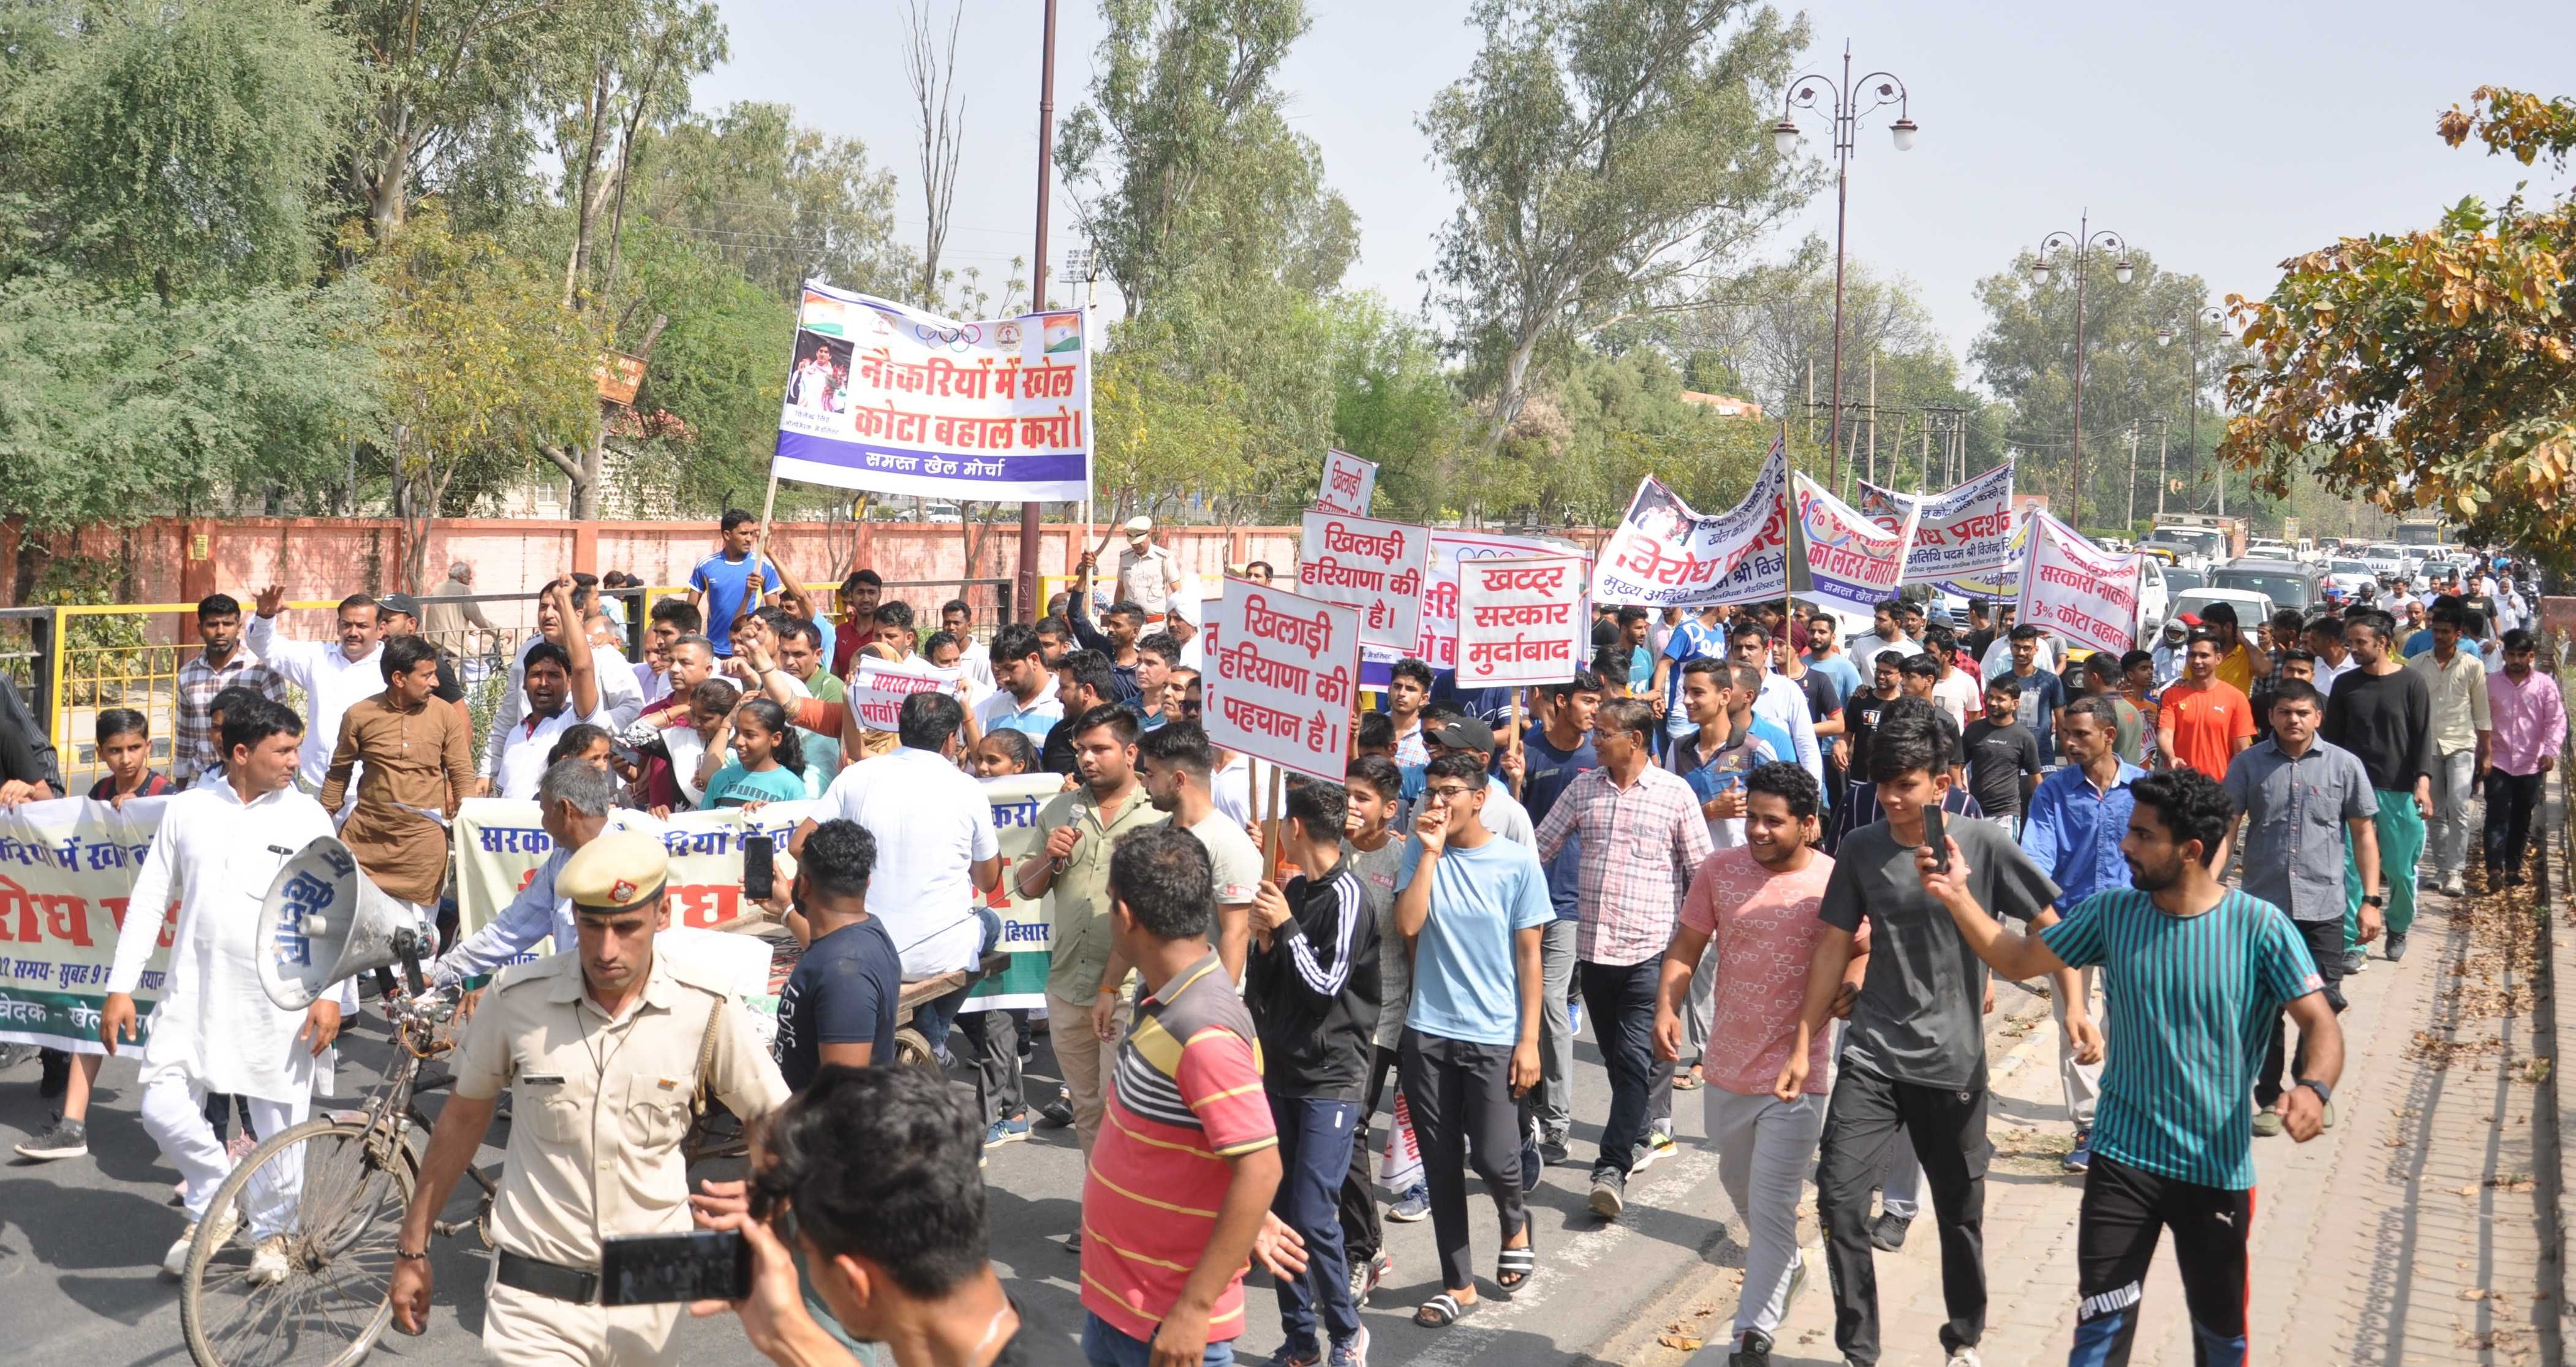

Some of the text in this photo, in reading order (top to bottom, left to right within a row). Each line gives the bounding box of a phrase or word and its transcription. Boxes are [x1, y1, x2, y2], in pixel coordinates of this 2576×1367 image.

[861, 347, 1076, 399] नौकरियों में खेल
[855, 399, 930, 444] कोटा
[935, 416, 1017, 449] बहाल
[866, 452, 1005, 477] समस्त खेल मोर्चा
[1330, 460, 1362, 502] खिलाड़ी
[1977, 486, 1999, 502] करने
[1324, 521, 1405, 565] खिलाड़ी
[1947, 502, 2011, 546] प्रदर्शन
[1615, 534, 1721, 585] विरोध
[1808, 541, 1833, 570] का
[1830, 542, 1867, 579] लेटर
[1864, 555, 1895, 585] जारी
[1907, 548, 1941, 564] अतिथि
[1944, 549, 1965, 560] पदम
[1966, 543, 1976, 558] श्री
[1301, 556, 1421, 597] हरियाणा की
[1603, 574, 1642, 596] मुख्य
[1733, 562, 1751, 583] श्री
[1823, 581, 1854, 597] समस्त
[1856, 589, 1873, 603] खेल
[1245, 594, 1332, 659] खिलाड़ी
[1473, 603, 1571, 627] सरकार
[2032, 600, 2053, 618] 3%
[2057, 603, 2091, 632] कोटा
[2091, 616, 2125, 648] बहाल
[1218, 641, 1349, 707] हरियाणा की
[1469, 632, 1573, 675] मुर्दाबाद
[861, 699, 893, 723] मोर्चा
[1223, 695, 1302, 743] पहचान
[54, 836, 81, 872] में
[0, 874, 94, 947] रोध
[1004, 920, 1049, 942] हिसार
[59, 963, 90, 989] सुबह
[90, 964, 101, 984] 9
[0, 992, 47, 1023] वेदक
